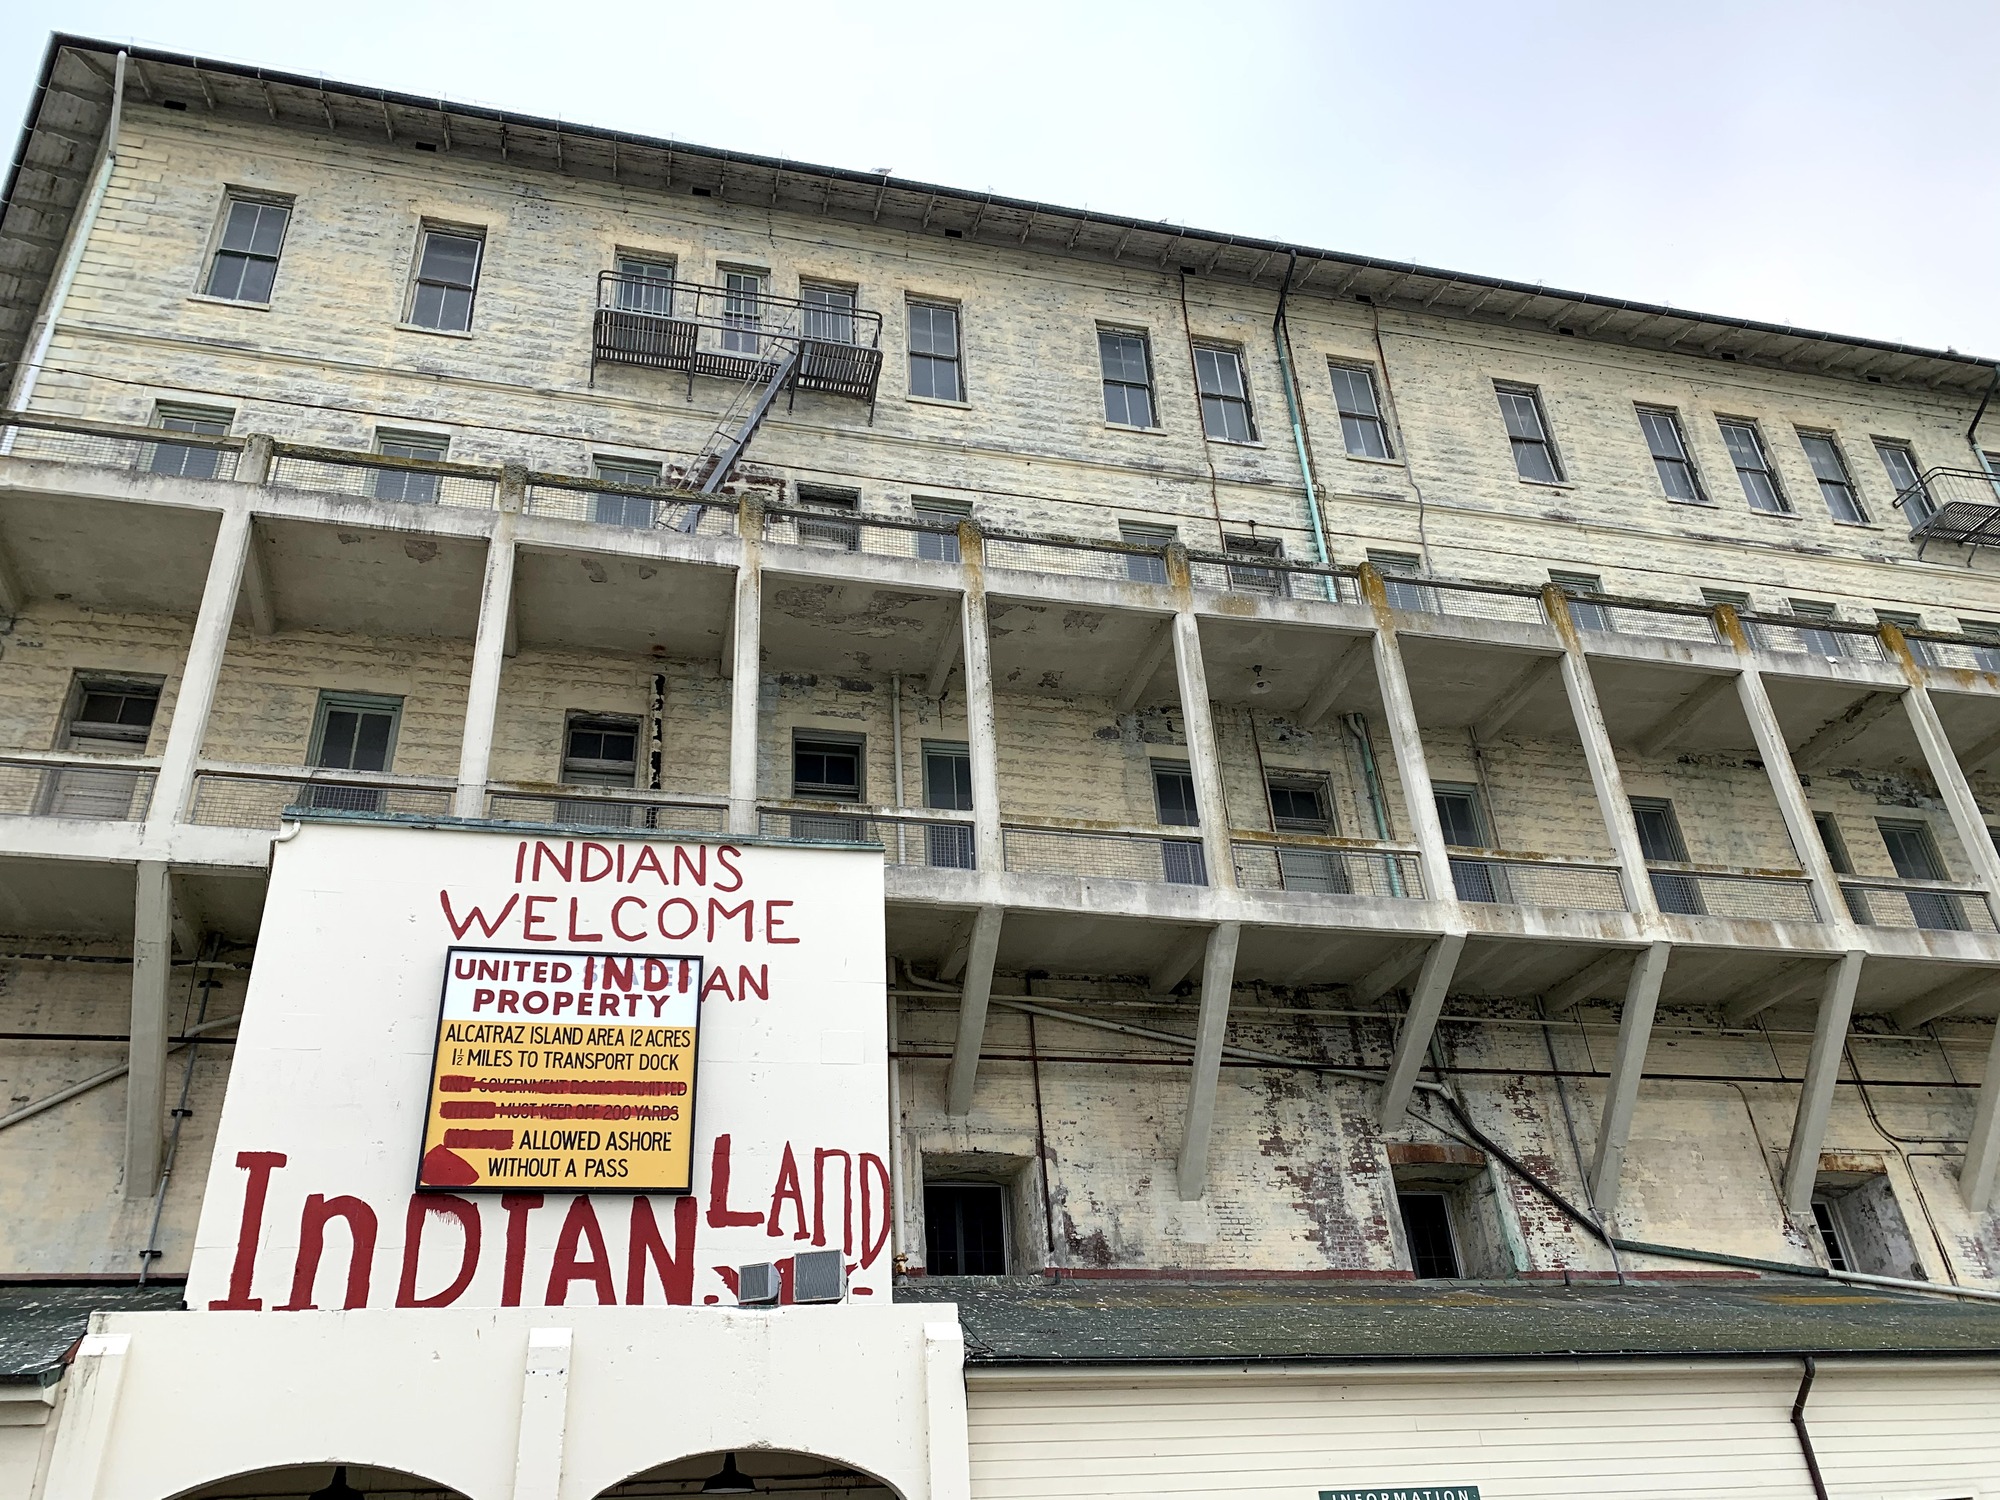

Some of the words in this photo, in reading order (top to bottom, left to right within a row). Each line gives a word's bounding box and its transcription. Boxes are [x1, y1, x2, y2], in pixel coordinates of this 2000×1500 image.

[516, 841, 743, 893] INDIANS
[440, 889, 800, 944] WELCOME
[455, 959, 572, 984] UNITED
[473, 989, 670, 1017] PROPERTY
[445, 1024, 526, 1044] ALCATRAZ
[530, 1026, 583, 1045] ISLAND
[586, 1028, 625, 1047] AREA
[630, 1029, 643, 1047] 12
[645, 1029, 691, 1048] ACRES
[467, 1049, 513, 1067] MILES
[518, 1050, 538, 1068] TO
[543, 1051, 634, 1070] TRANSPORT
[639, 1053, 679, 1071] DOCK
[518, 1130, 601, 1151] ALLOWED
[605, 1131, 672, 1152] ASHORE
[488, 1157, 561, 1178] WITHOUT
[564, 1159, 577, 1178] A
[584, 1159, 629, 1178] PASS
